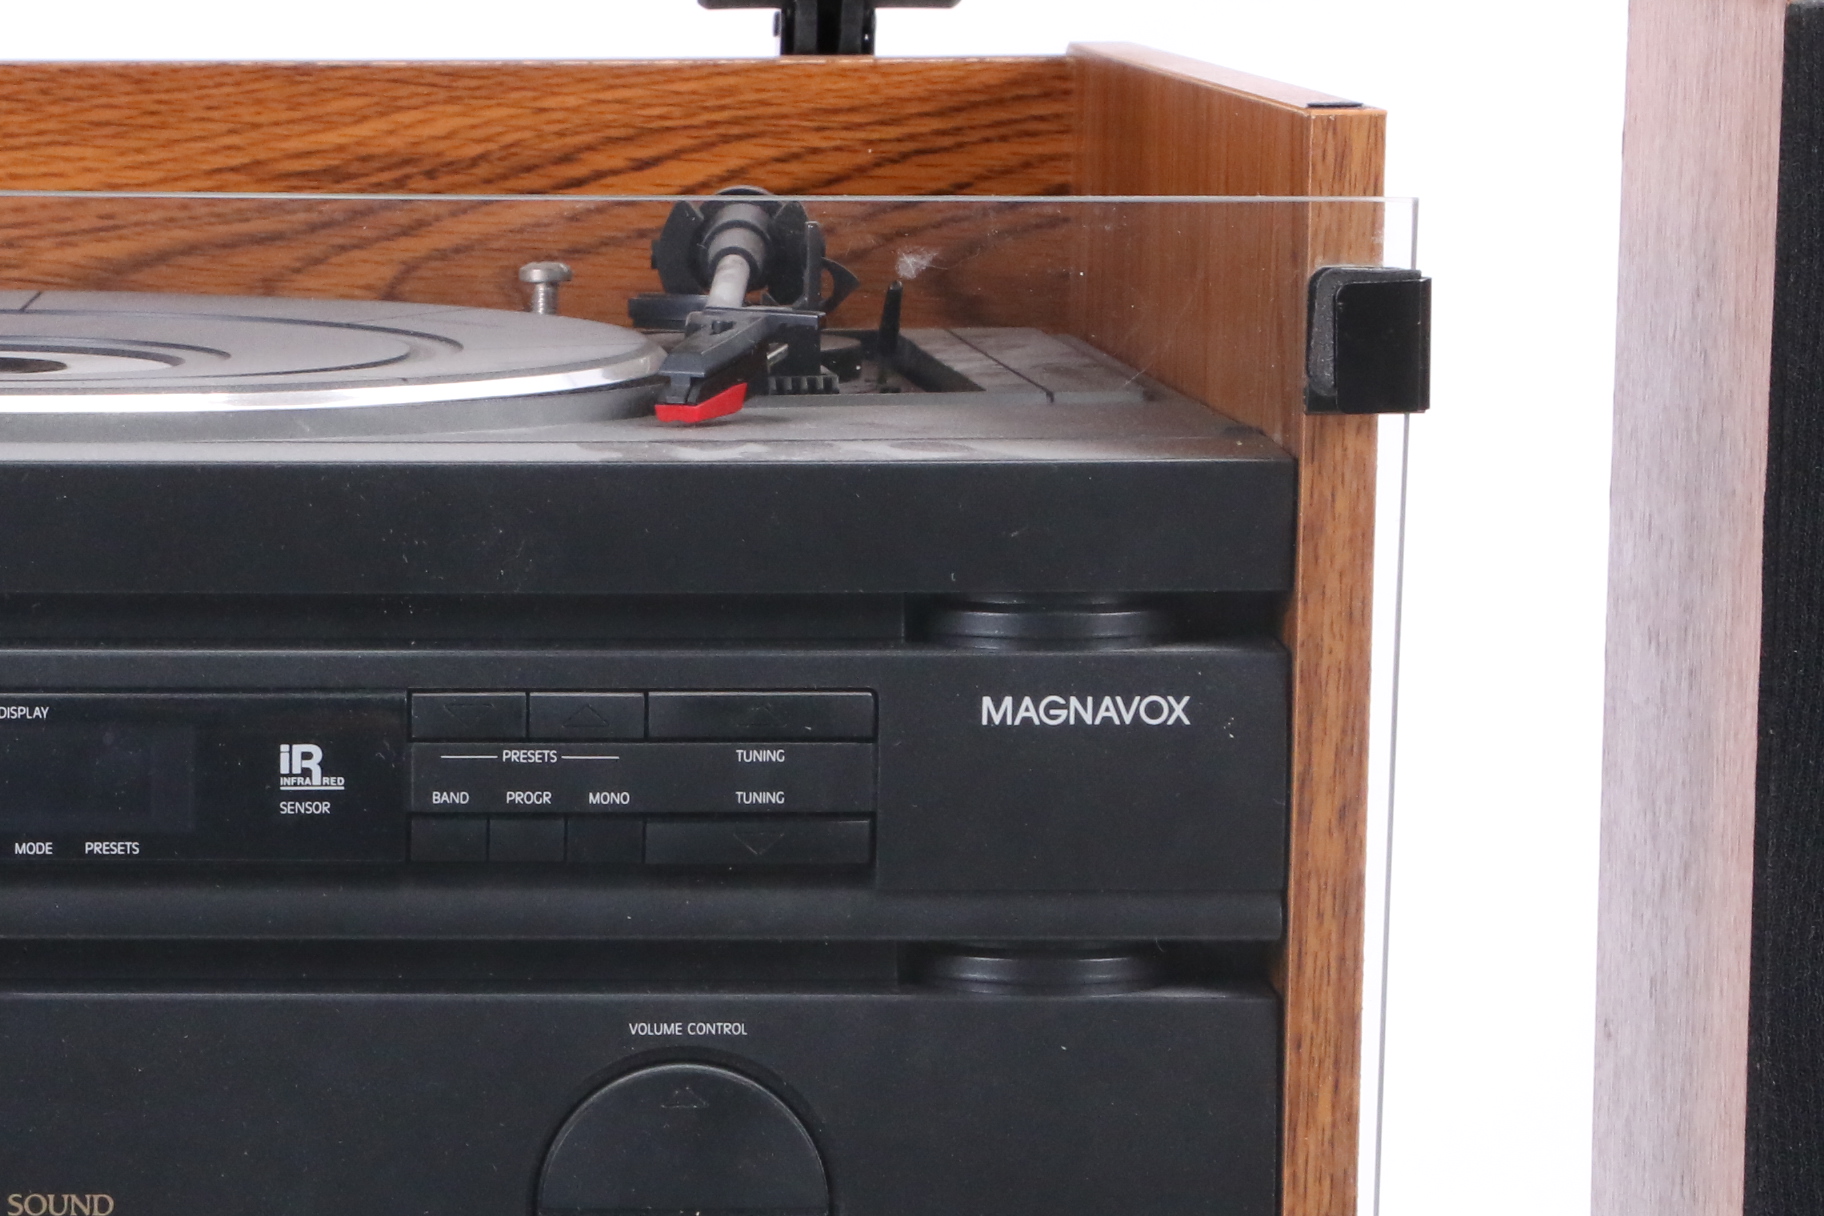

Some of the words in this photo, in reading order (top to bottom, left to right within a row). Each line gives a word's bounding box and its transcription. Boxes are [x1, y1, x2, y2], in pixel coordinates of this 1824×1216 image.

[982, 696, 1190, 725] MAGNAVOX
[503, 750, 557, 762] PRESETS
[736, 750, 785, 762] TUNING
[433, 792, 469, 804] BAND
[507, 792, 551, 804] PROGR
[589, 792, 629, 804] MONO
[736, 791, 784, 804] TUNING
[280, 802, 330, 814] SENSOR
[15, 842, 52, 854] MODE
[85, 842, 139, 854] PRESETS
[629, 1023, 682, 1035] VOLUME
[688, 1023, 747, 1035] CONTROL
[8, 1194, 114, 1216] SOUND
